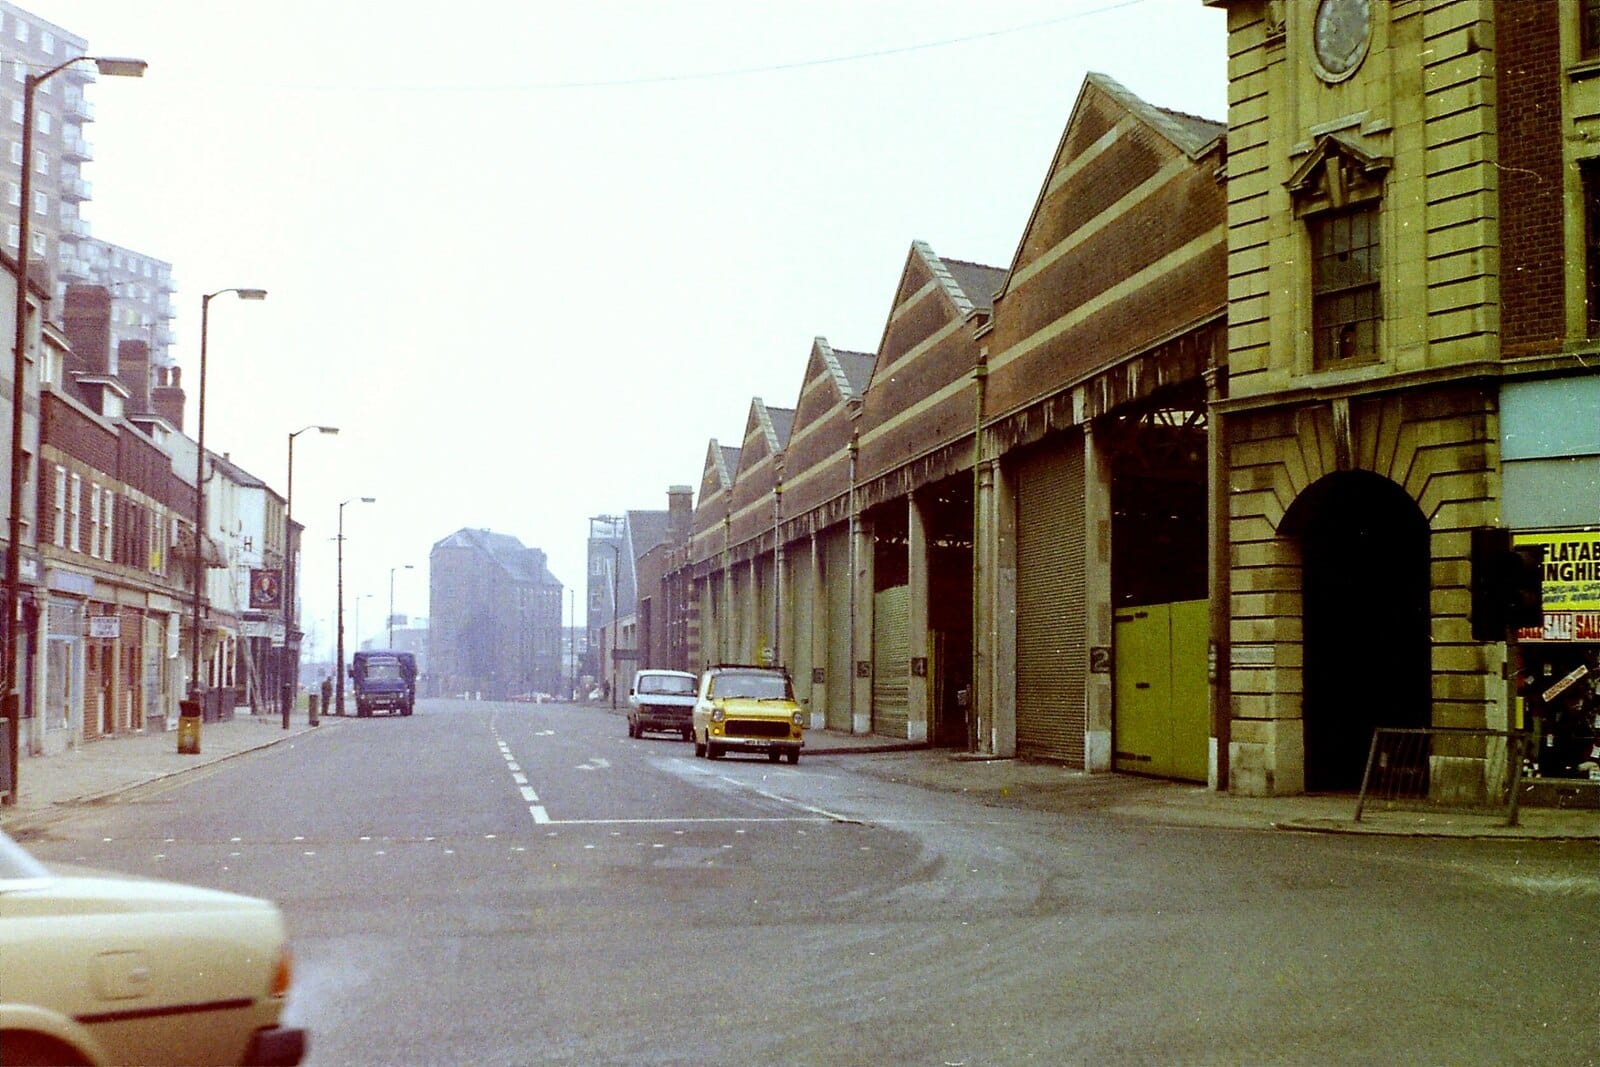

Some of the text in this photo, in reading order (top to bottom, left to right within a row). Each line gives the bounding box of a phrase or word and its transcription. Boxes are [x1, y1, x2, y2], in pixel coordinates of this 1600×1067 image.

[1544, 614, 1571, 639] SALE
[914, 658, 924, 676] 4
[1093, 649, 1109, 671] 2
